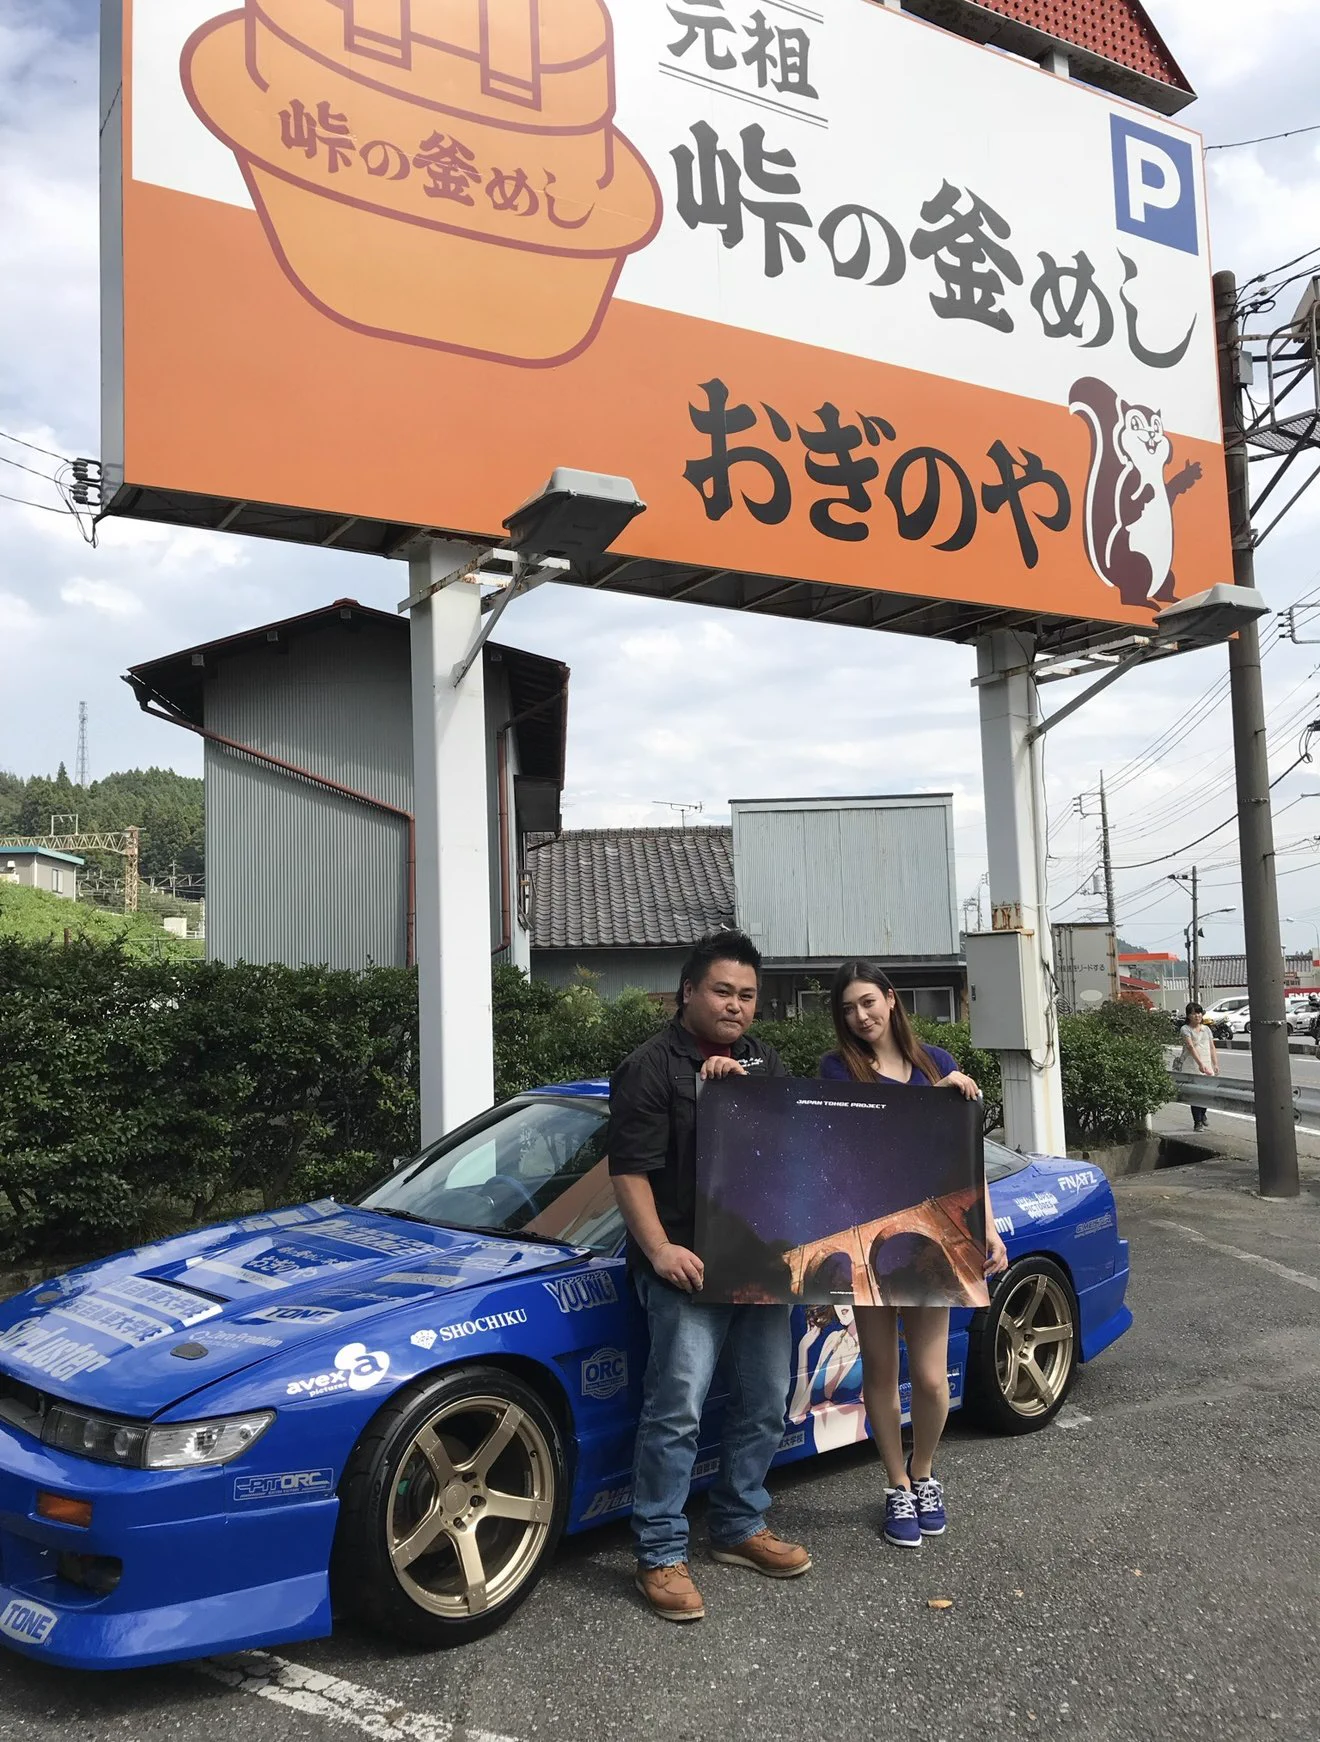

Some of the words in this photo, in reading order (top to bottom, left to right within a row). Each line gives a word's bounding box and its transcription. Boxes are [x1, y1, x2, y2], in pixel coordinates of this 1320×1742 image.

[665, 0, 820, 100] 元祖
[278, 98, 597, 229] 峠の釜めし
[1124, 133, 1182, 224] P
[669, 119, 1198, 369] 峠の釜めし
[682, 377, 1072, 570] おぎのや
[266, 1307, 335, 1321] TONE
[439, 1308, 528, 1342] SHOCHIKU
[286, 1369, 346, 1396] avex
[585, 1357, 624, 1383] ORC
[309, 1381, 348, 1398] pictures
[3, 1603, 54, 1640] TONE
